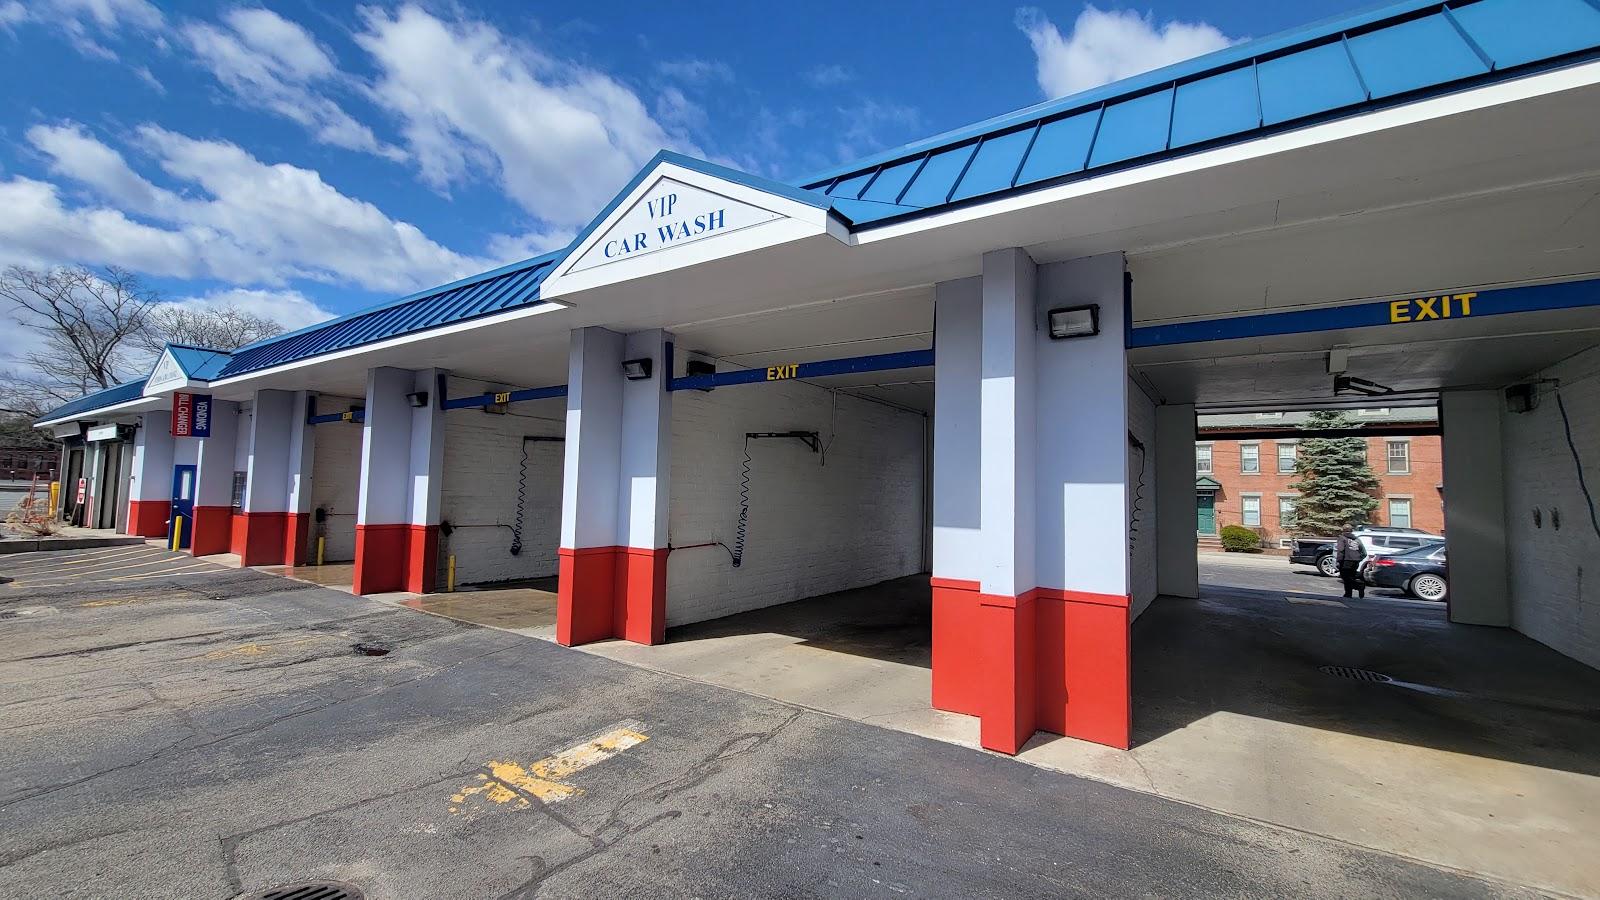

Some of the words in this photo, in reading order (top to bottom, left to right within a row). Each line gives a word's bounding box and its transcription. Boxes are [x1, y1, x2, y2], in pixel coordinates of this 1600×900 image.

[647, 193, 677, 220] VIP
[604, 232, 648, 258] CAR
[657, 208, 726, 243] WASH
[1390, 292, 1478, 324] EXIT
[766, 364, 799, 381] EXIT
[495, 392, 511, 403] EXIT
[176, 406, 189, 435] CHANGER
[195, 401, 208, 430] VENDING
